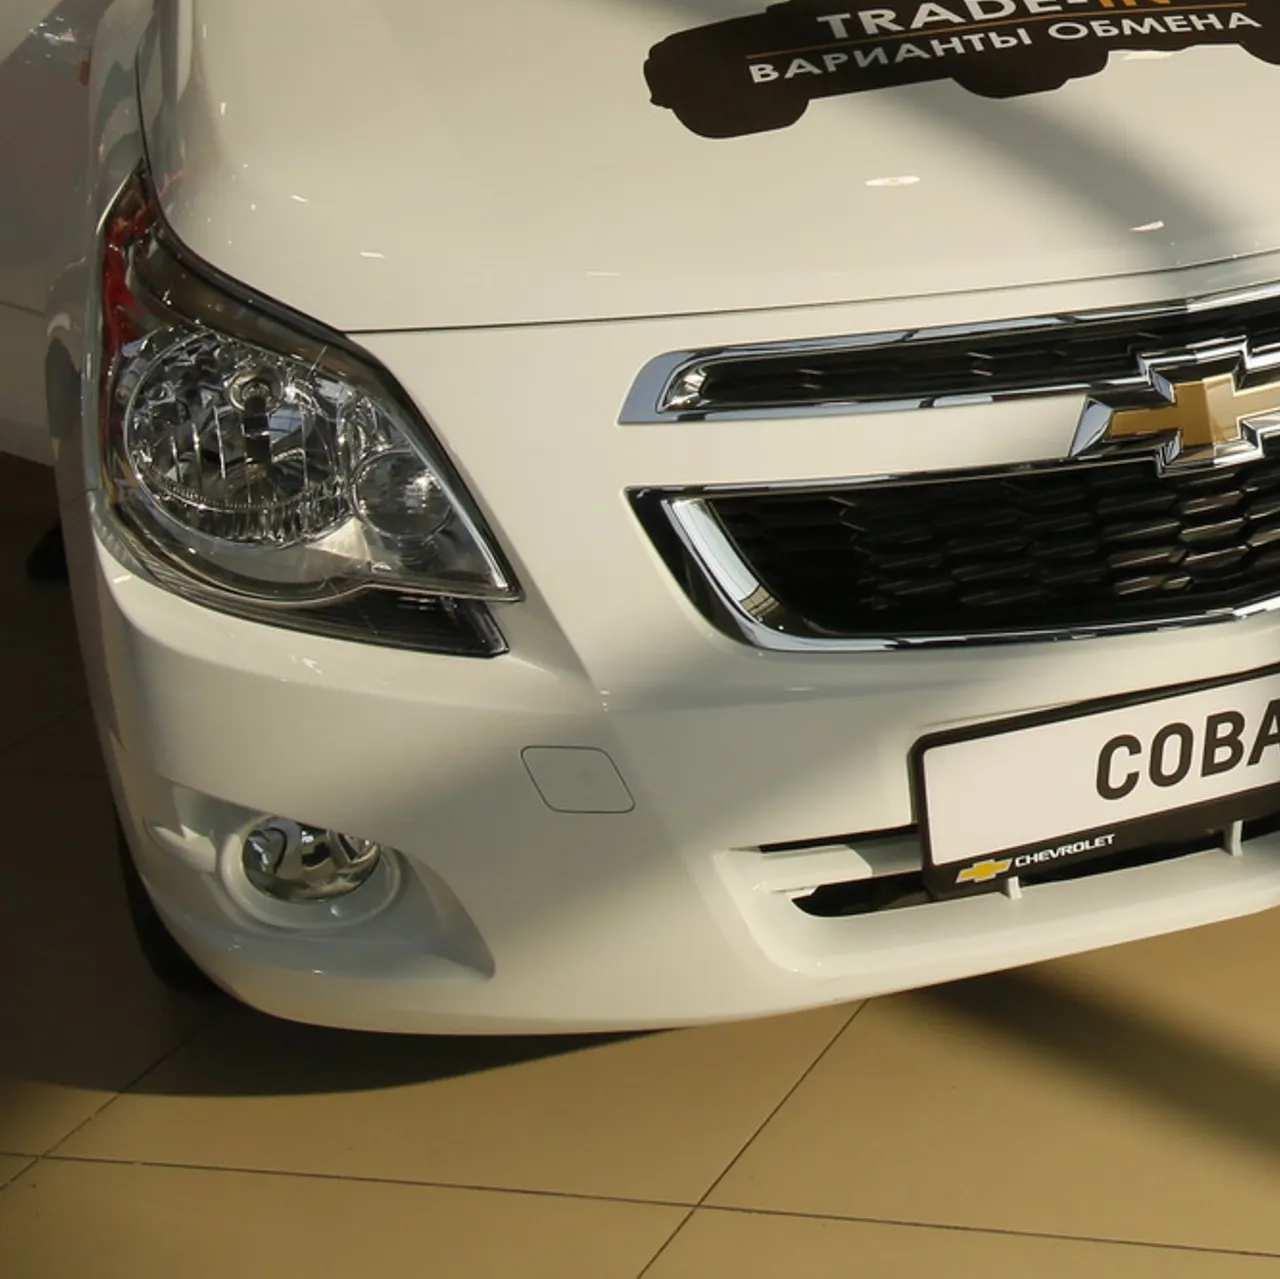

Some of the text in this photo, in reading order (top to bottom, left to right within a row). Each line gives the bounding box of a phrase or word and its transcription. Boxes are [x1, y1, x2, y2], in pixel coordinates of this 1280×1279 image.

[748, 11, 1263, 84] ВАРИАНТЫ ОБМЕНА
[1015, 833, 1116, 868] CHEVROLET
